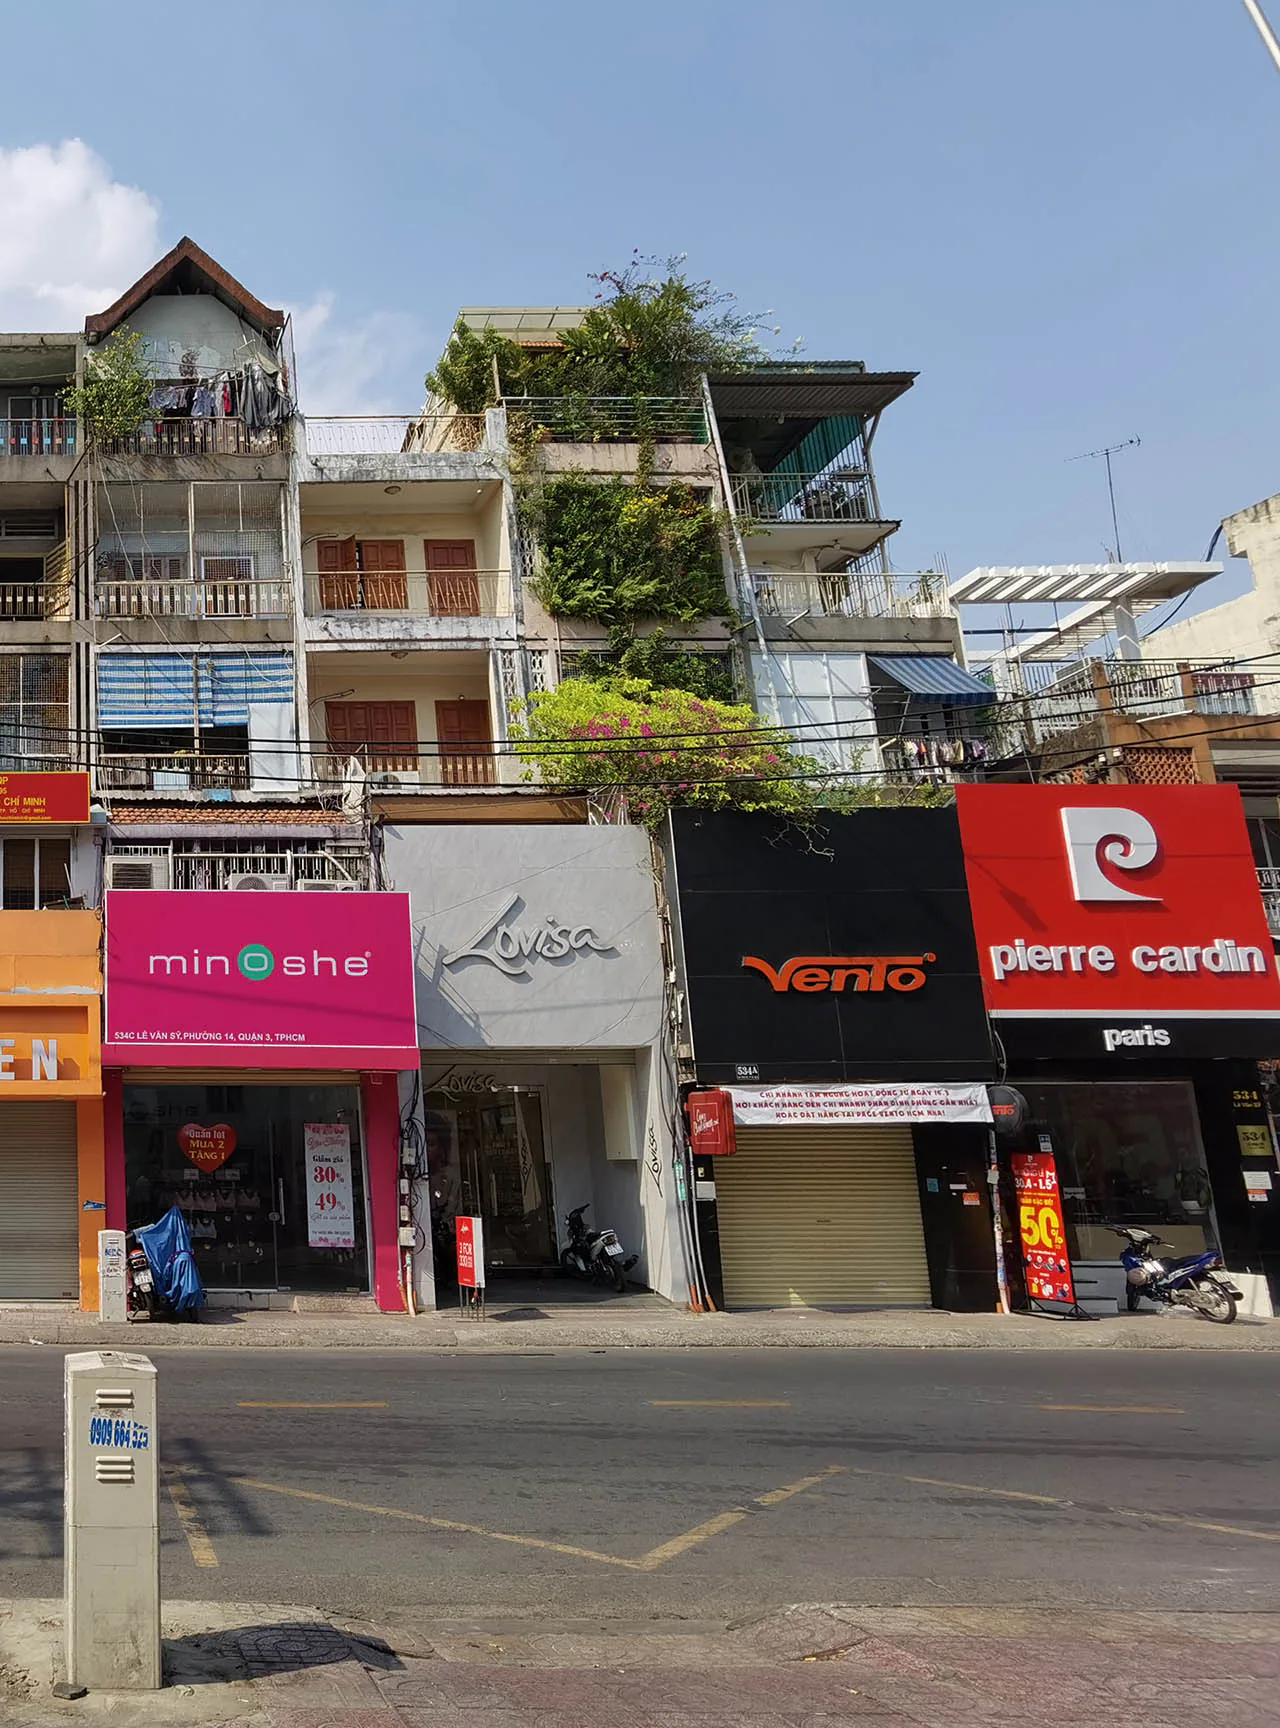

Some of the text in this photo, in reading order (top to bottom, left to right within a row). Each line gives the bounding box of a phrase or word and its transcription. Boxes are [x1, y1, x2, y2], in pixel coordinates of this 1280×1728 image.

[3, 796, 20, 806] CHÍ
[23, 797, 46, 806] MINH
[443, 893, 614, 975] Lovisa
[989, 938, 1267, 980] pierre cardin
[137, 1030, 148, 1040] LÊ
[149, 1030, 168, 1040] VĂN
[275, 1032, 306, 1042] TPHCM
[1103, 1025, 1171, 1051] paris
[189, 1140, 225, 1149] MUA 2
